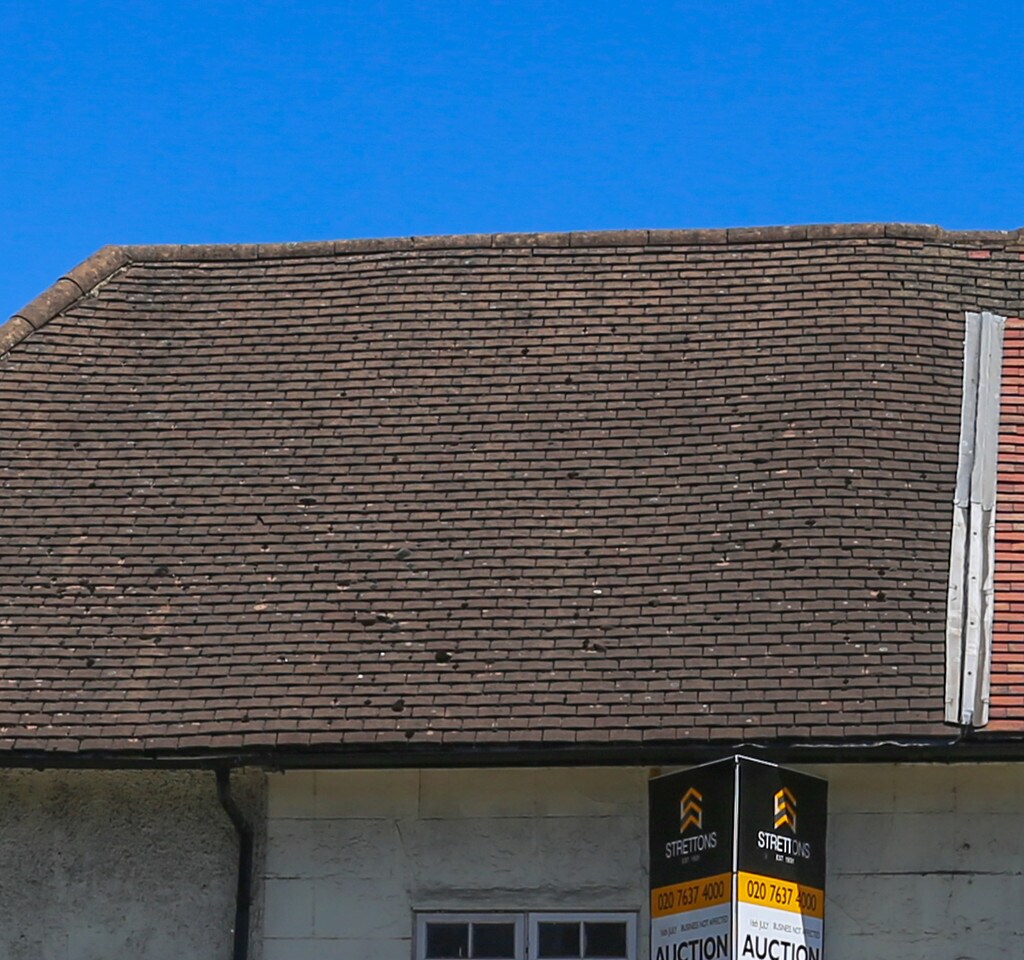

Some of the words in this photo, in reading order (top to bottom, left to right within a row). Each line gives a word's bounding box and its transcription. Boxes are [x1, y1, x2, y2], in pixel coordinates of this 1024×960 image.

[665, 832, 717, 858] STRETTONS
[757, 831, 811, 859] STRETTONS
[657, 891, 674, 911] 020
[677, 886, 699, 907] 7637
[702, 881, 725, 901] 4000
[747, 880, 767, 900] 020
[770, 884, 793, 906] 7637
[795, 891, 817, 912] 4000
